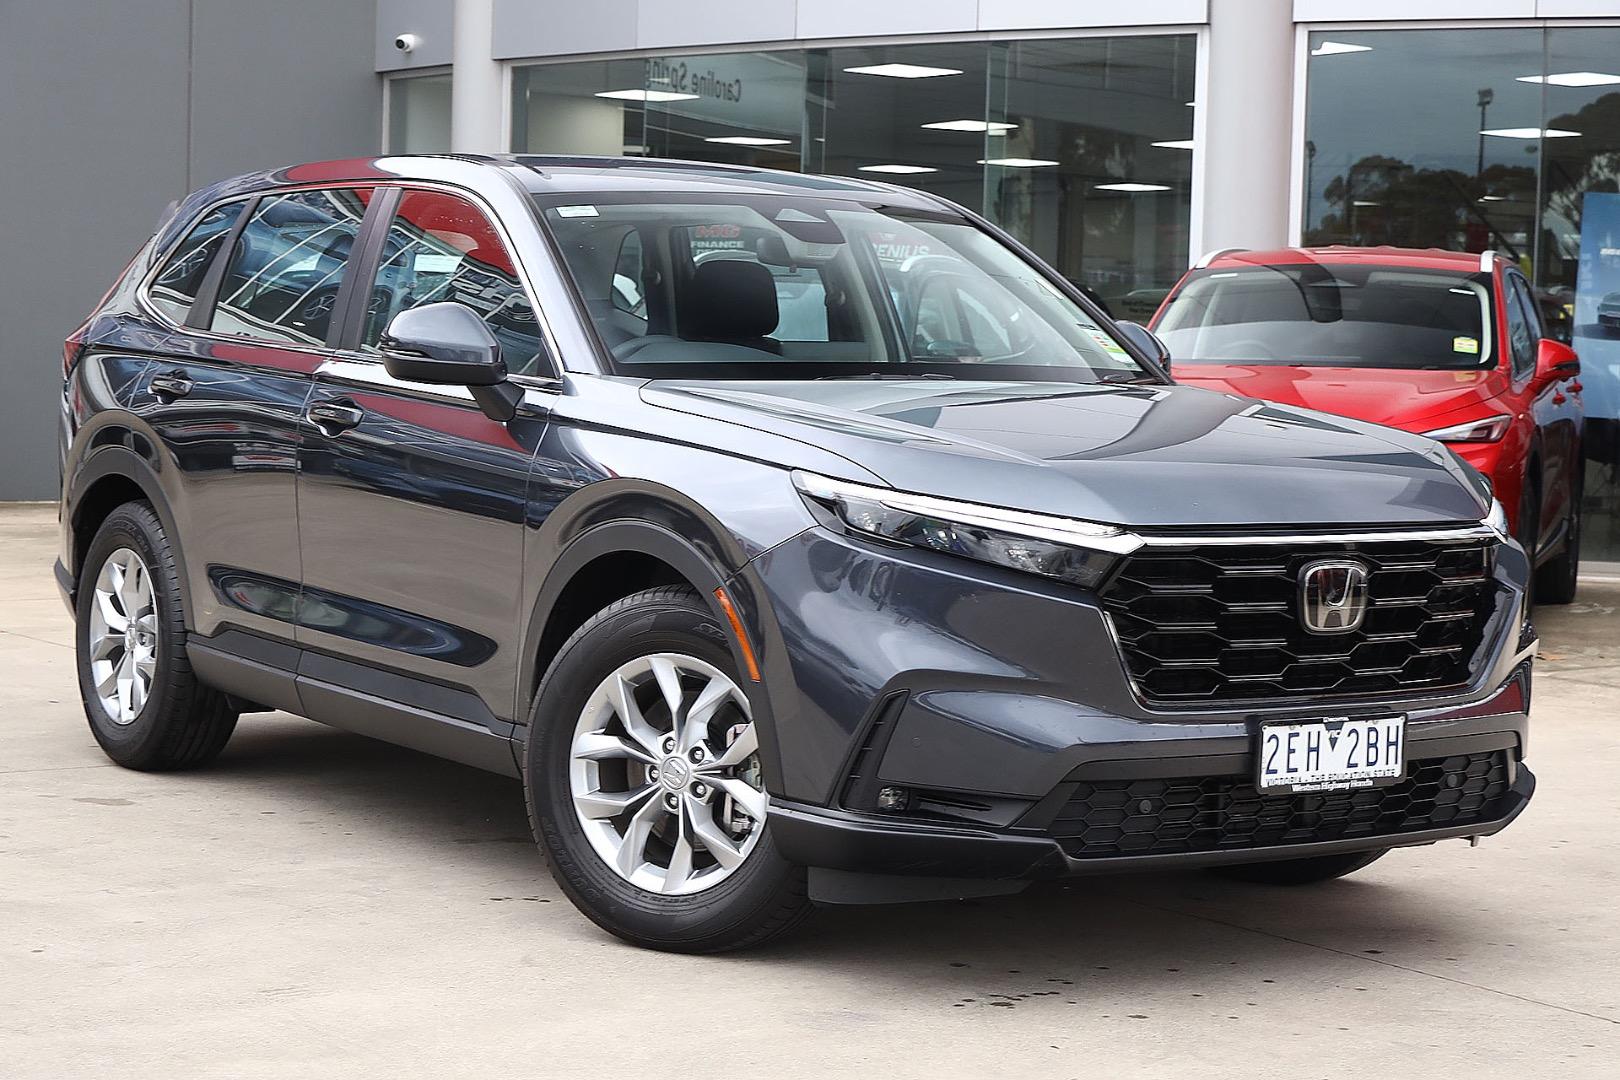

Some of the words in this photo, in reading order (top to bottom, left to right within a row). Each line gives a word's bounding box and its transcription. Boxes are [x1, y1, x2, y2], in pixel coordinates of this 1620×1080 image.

[690, 240, 745, 249] FINANCE
[872, 243, 930, 258] ENIUS
[1265, 731, 1321, 774] 2EH
[1346, 725, 1399, 768] 2BH
